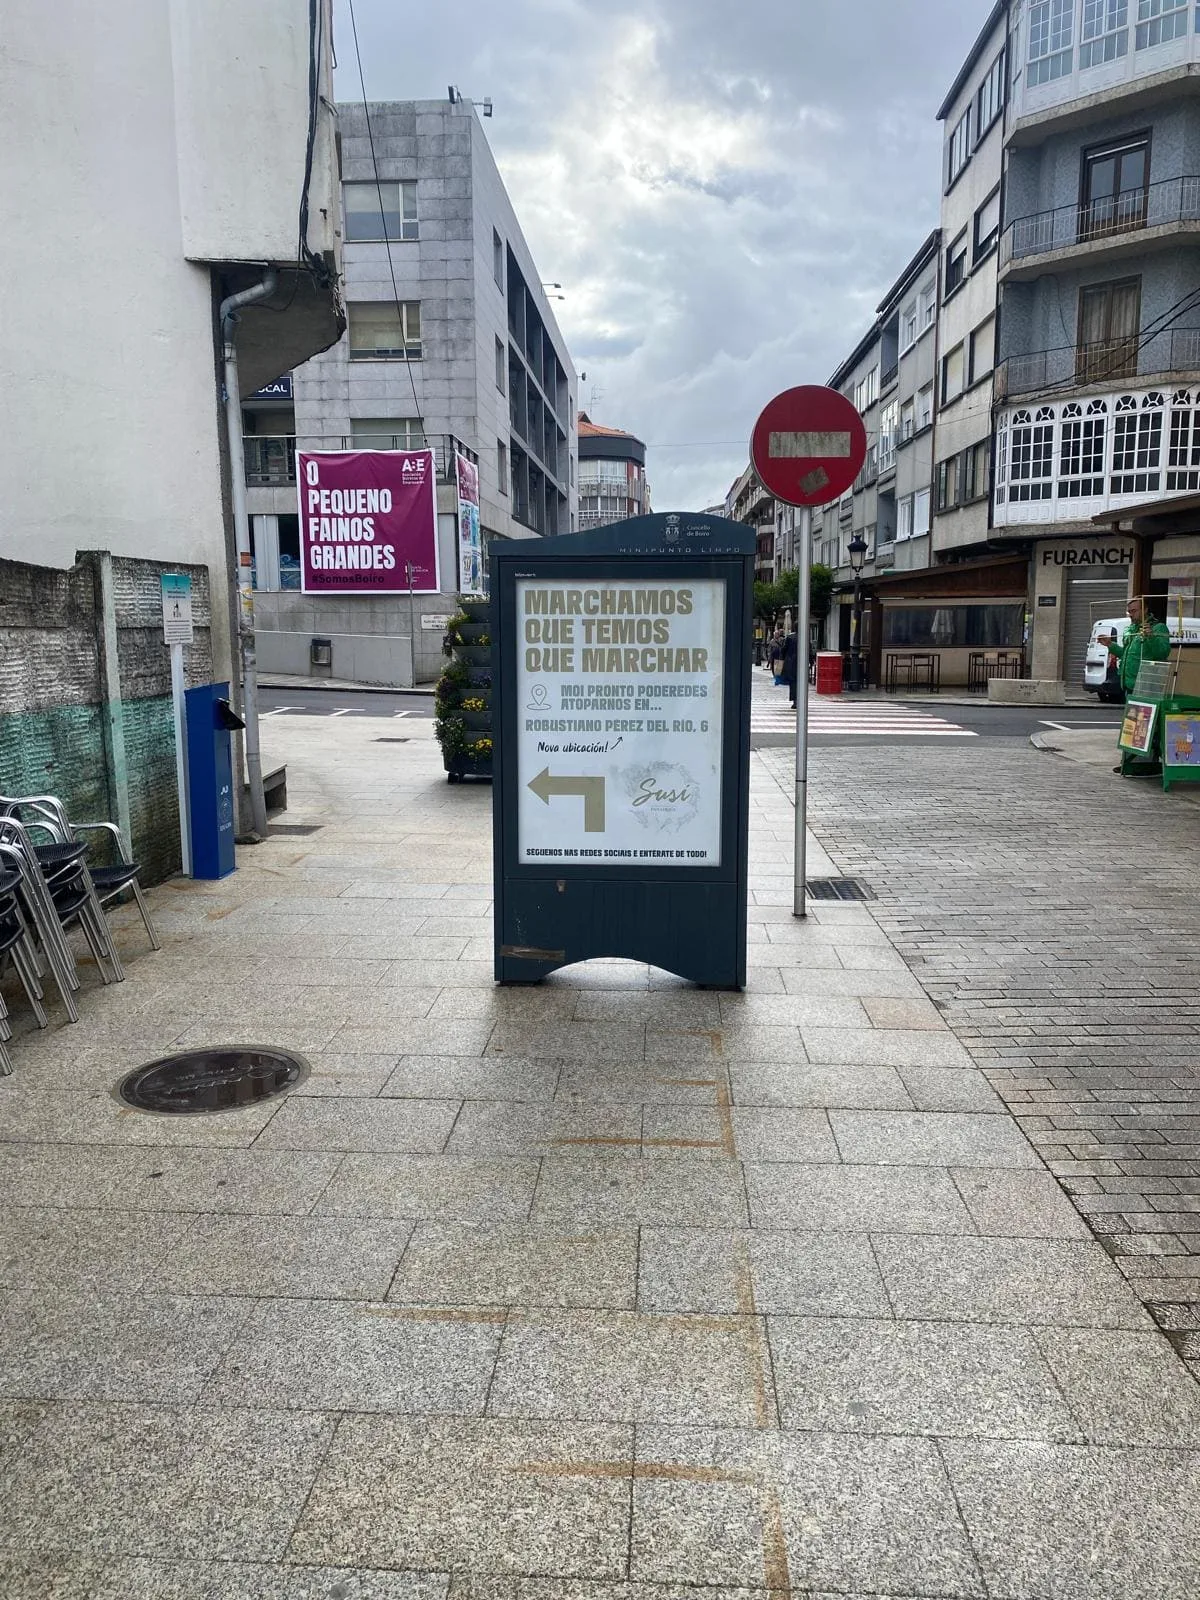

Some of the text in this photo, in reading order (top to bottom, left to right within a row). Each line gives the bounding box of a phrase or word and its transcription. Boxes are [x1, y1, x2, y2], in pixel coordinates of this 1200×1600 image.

[306, 460, 320, 486] O
[308, 489, 393, 515] PEQUENO
[309, 517, 375, 542] FAINOS
[310, 545, 396, 570] GRANDES
[312, 573, 385, 584] #SomosBoiro
[524, 589, 693, 615] MARCHAMOS
[525, 618, 670, 644] QUE TEMOS
[525, 648, 708, 673] QUE MARCHAR
[561, 684, 708, 697] MOI PRONTO PODEREDES
[561, 698, 662, 711] ATOPARNOS EN...
[525, 719, 602, 732] ROBUSTIANO
[646, 719, 669, 732] DEL
[700, 720, 709, 732] 6
[537, 741, 609, 753] Nova ubicación!
[632, 777, 691, 807] Susi
[564, 849, 579, 857] NAS
[580, 849, 602, 857] REDES
[604, 849, 632, 857] SOCIAIS
[675, 850, 685, 858] DE
[686, 850, 707, 858] TODO!
